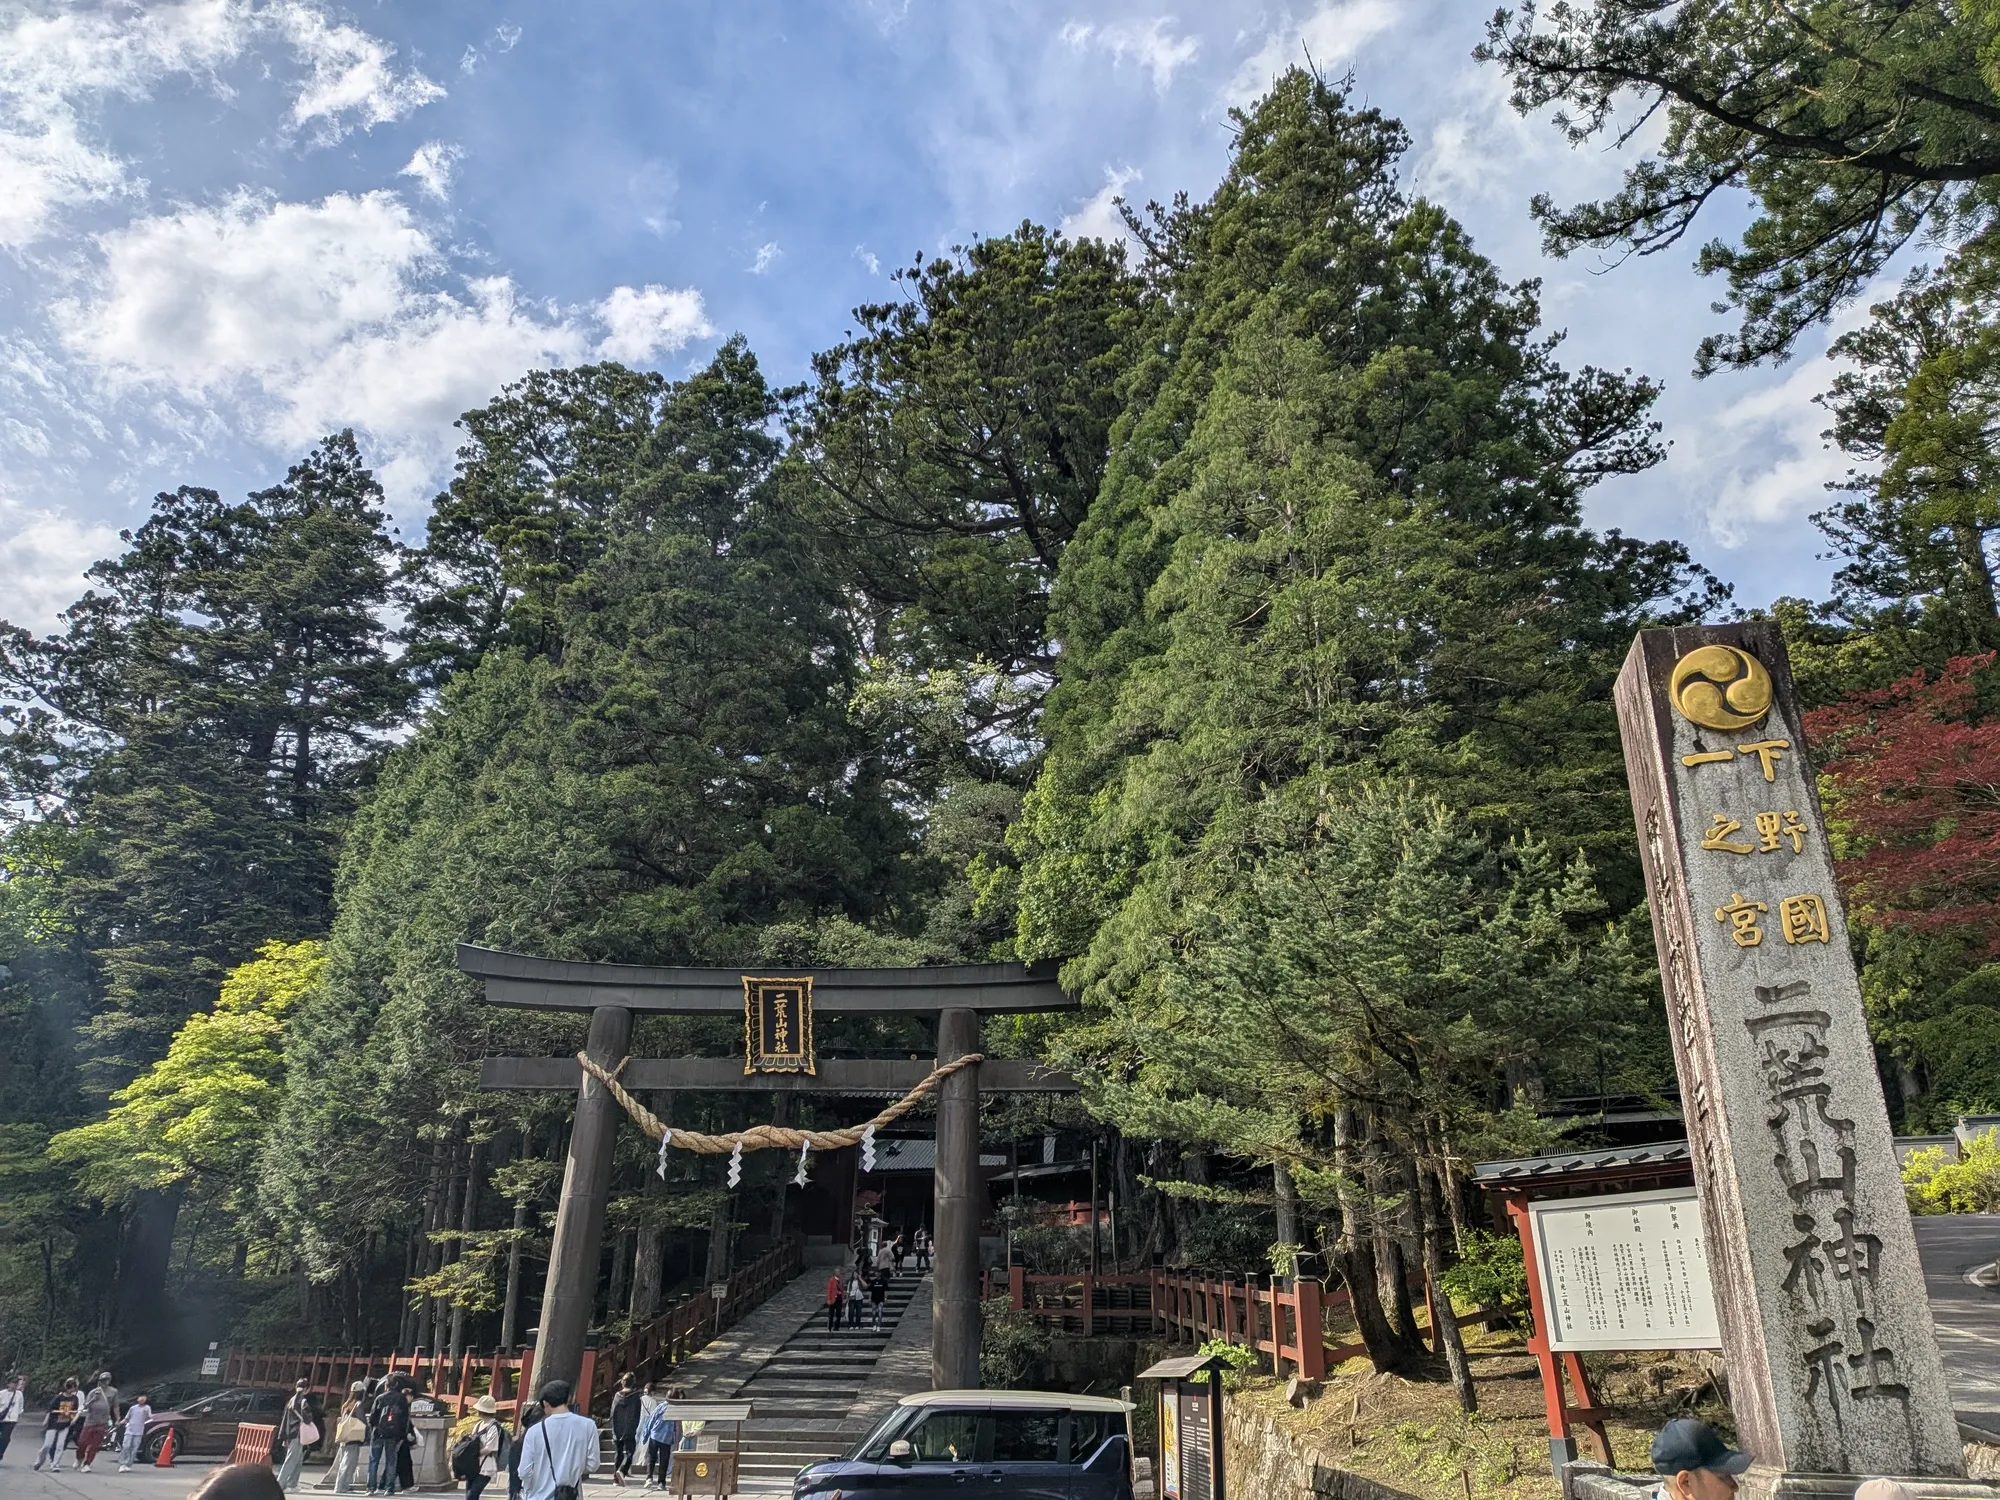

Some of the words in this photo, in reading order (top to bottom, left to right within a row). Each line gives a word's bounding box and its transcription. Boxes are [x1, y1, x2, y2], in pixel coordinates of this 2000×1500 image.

[1681, 750, 1768, 947] 一之宮
[1738, 739, 1831, 944] 下野國
[773, 992, 789, 1054] 二荒山神社
[1584, 1213, 1594, 1237] 御境内
[1631, 1209, 1642, 1233] 御社殿
[1669, 1205, 1680, 1230] 御祭典
[1744, 980, 1911, 1413] 二荒山神社
[1559, 1275, 1573, 1330] 日光二荒山神社
